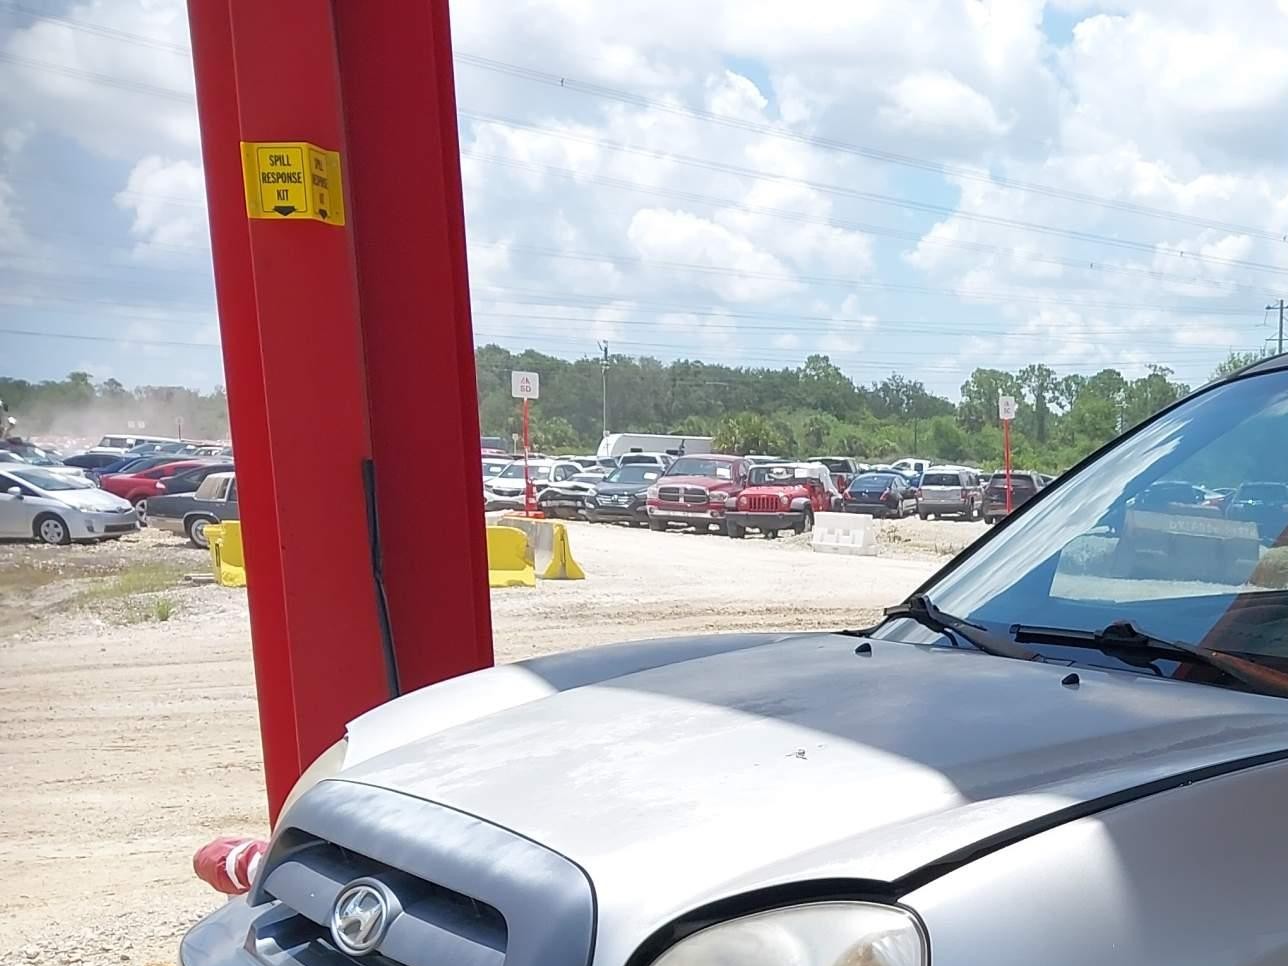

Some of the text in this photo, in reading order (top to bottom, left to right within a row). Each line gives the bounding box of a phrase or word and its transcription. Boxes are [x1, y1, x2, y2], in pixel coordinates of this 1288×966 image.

[268, 154, 292, 167] SPILL
[261, 171, 303, 184] RESPONSE
[276, 189, 289, 201] KIT
